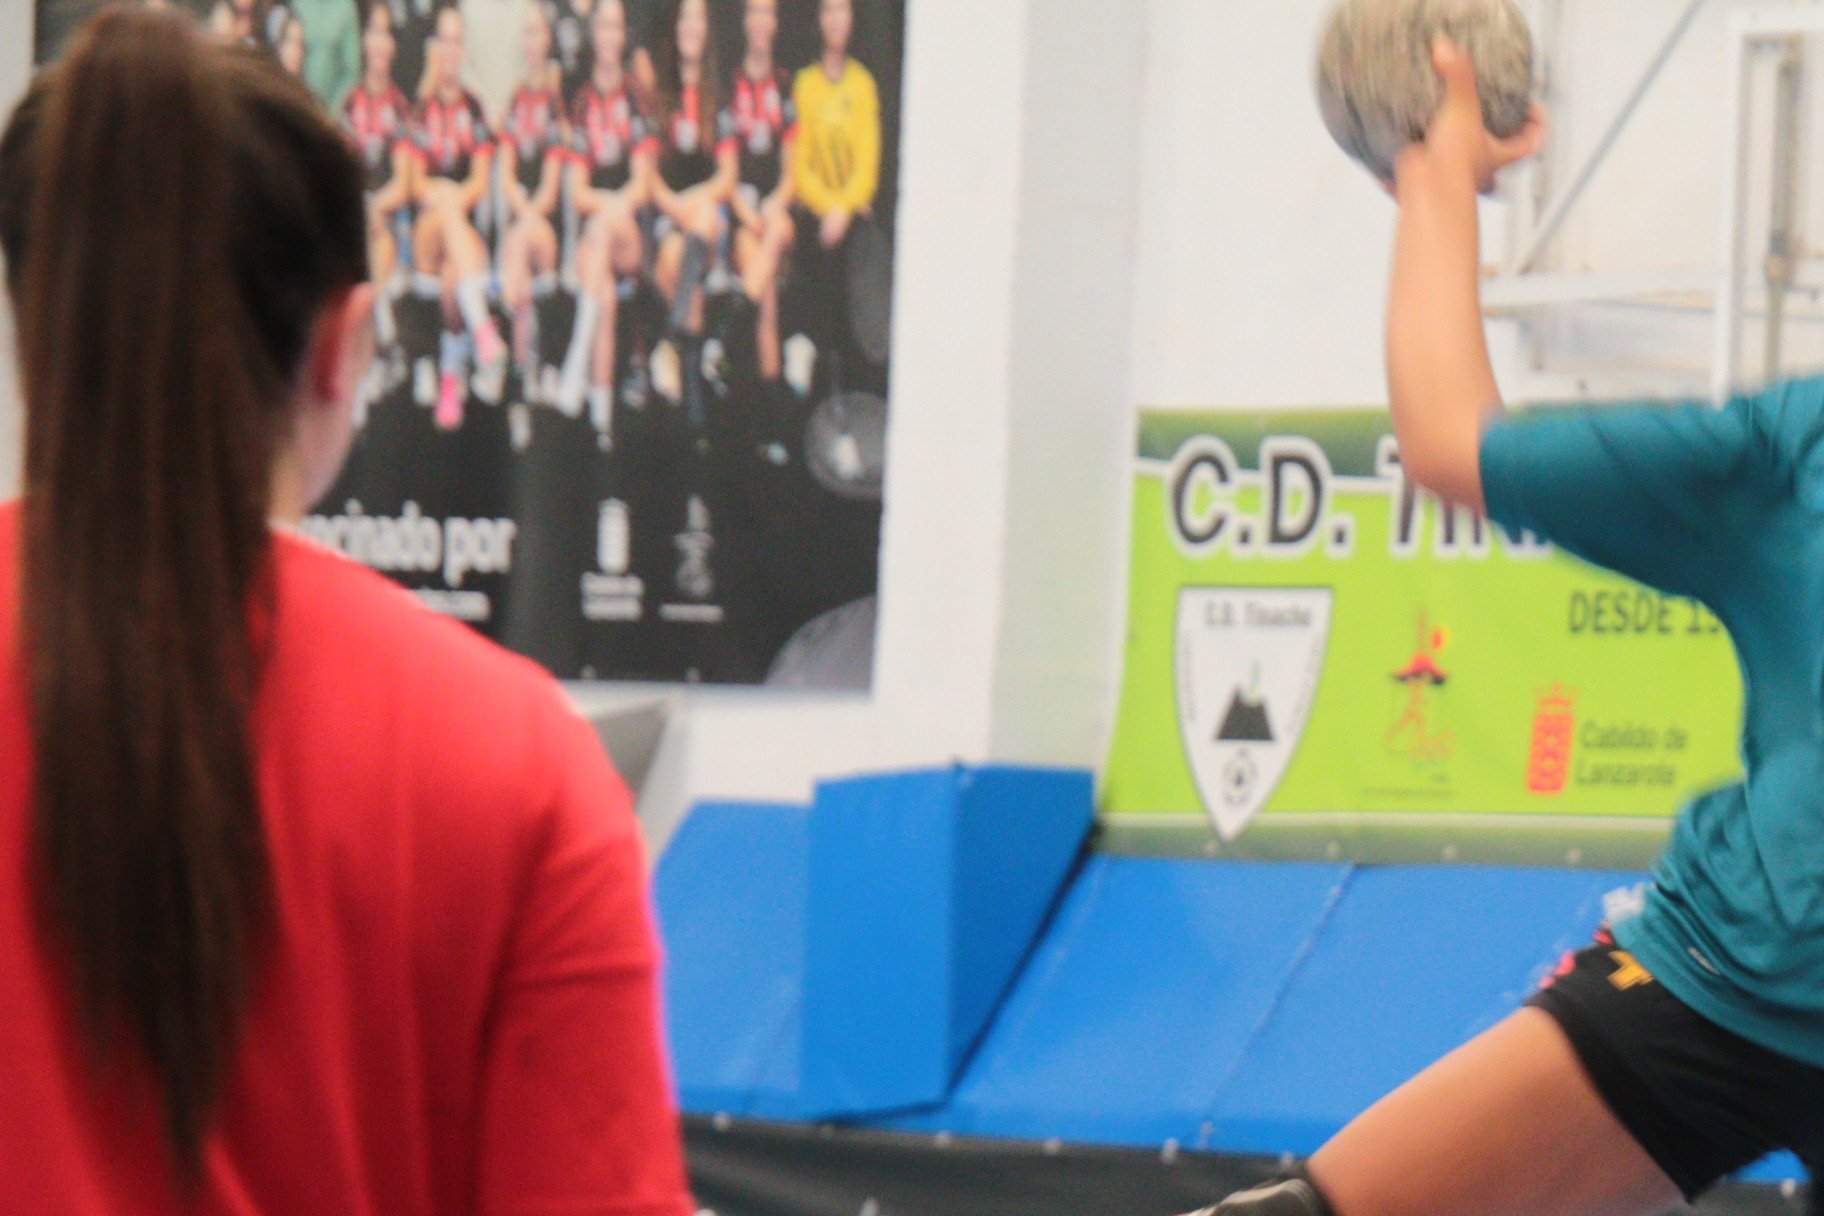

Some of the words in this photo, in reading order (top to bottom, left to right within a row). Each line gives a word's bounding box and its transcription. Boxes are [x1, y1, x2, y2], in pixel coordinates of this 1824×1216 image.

[1168, 445, 1350, 552] C.D.
[444, 516, 516, 588] por
[1568, 590, 1675, 636] DESDE
